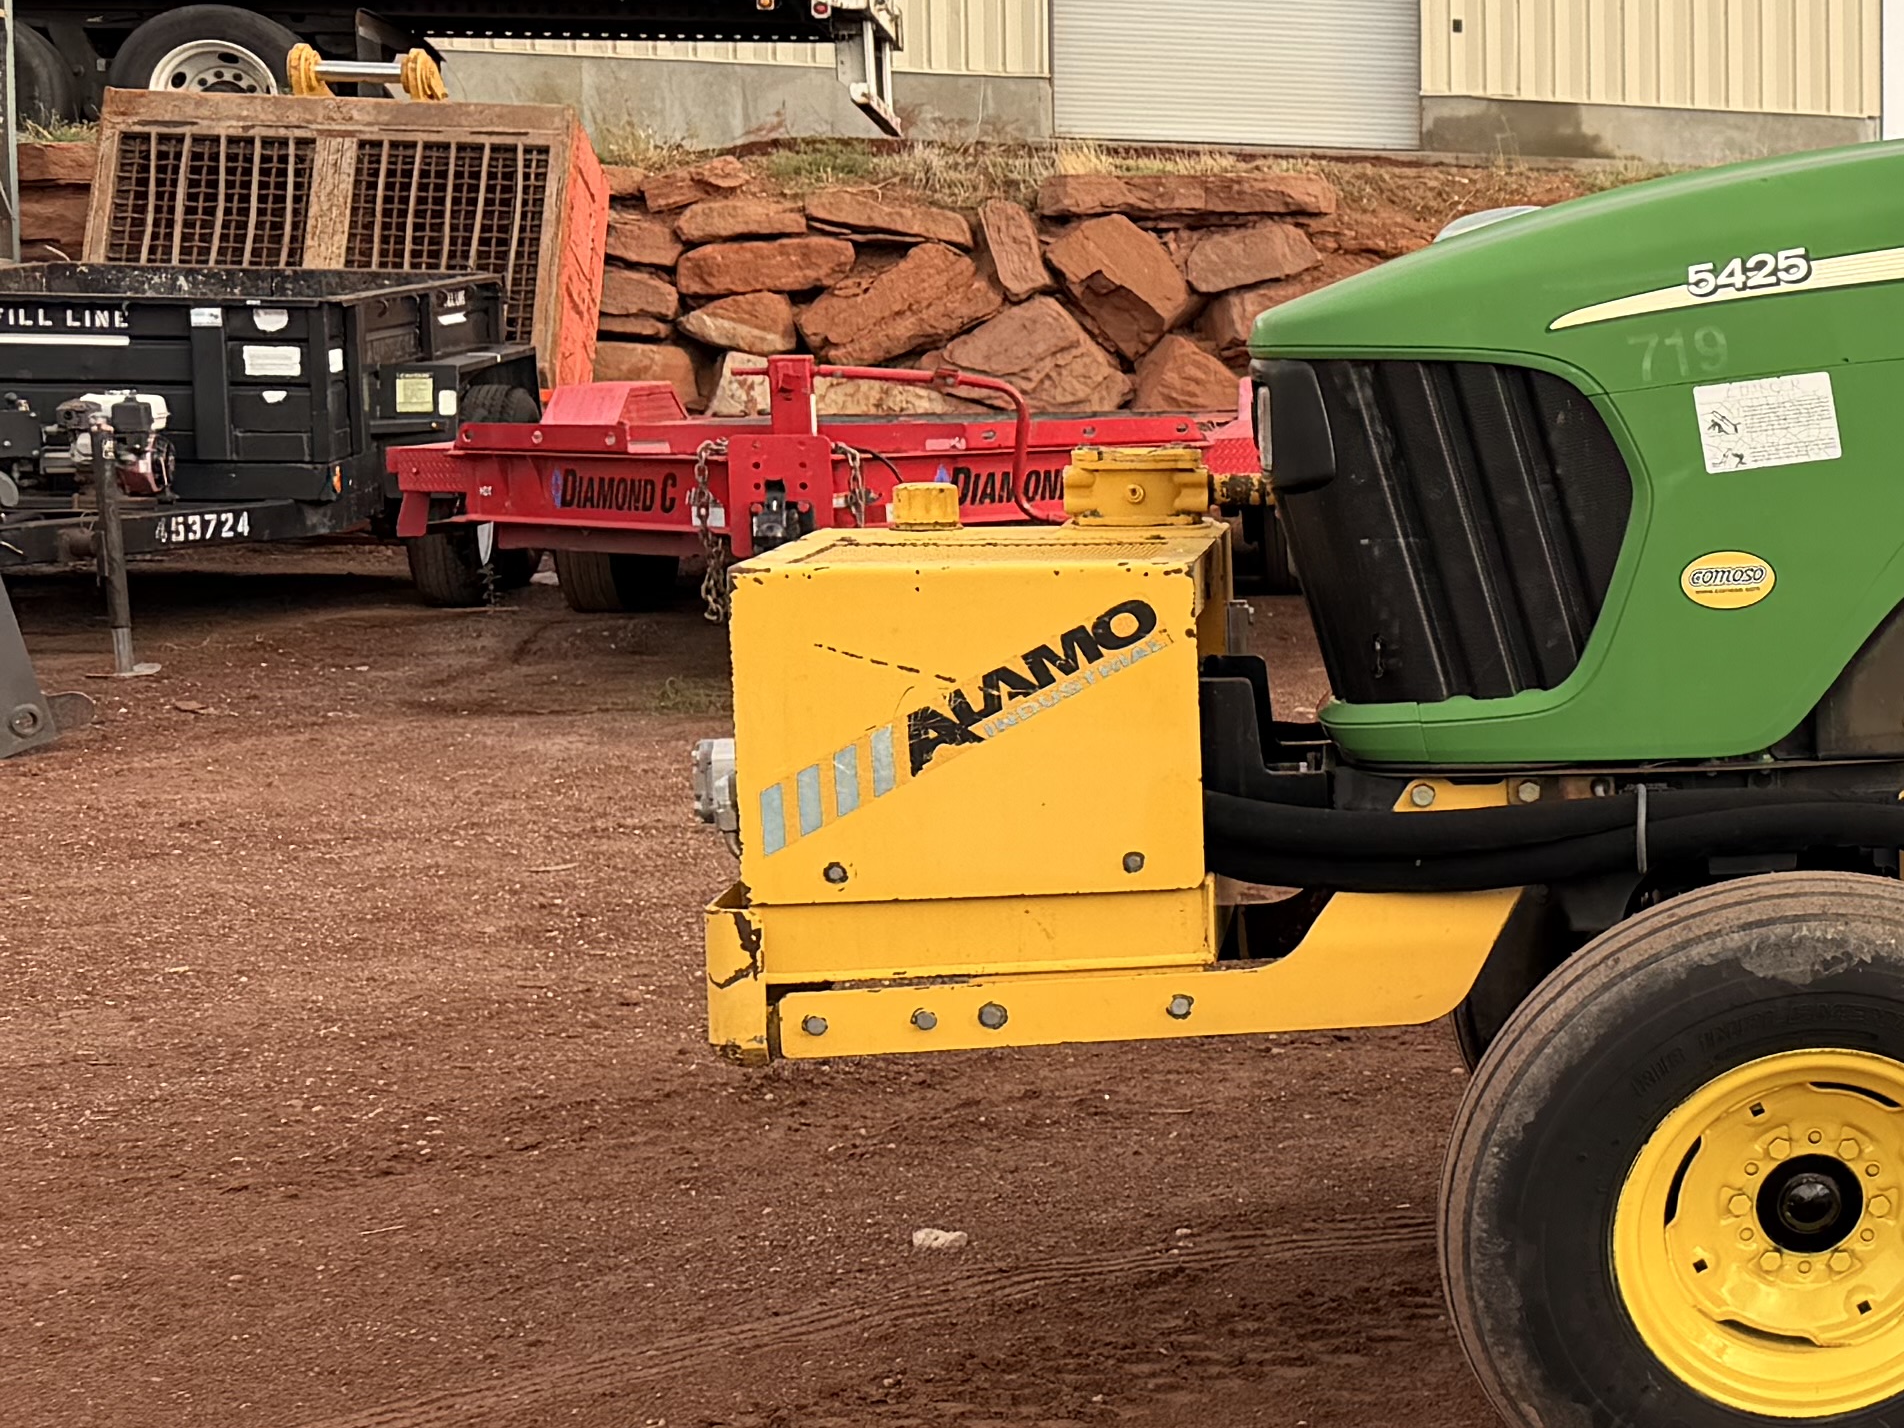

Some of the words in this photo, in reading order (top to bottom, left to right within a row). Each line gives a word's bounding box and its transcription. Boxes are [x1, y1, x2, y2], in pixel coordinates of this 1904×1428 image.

[1687, 247, 1812, 297] 5425
[0, 307, 53, 327] ILL
[66, 308, 129, 328] LINE
[1626, 325, 1729, 382] 719
[560, 468, 656, 512] DIAMOND
[660, 471, 678, 514] C
[951, 466, 1064, 506] DIAMON
[155, 510, 250, 543] 453724
[906, 598, 1158, 778] ALAMO
[984, 637, 1165, 739] INDUSTRIAL
